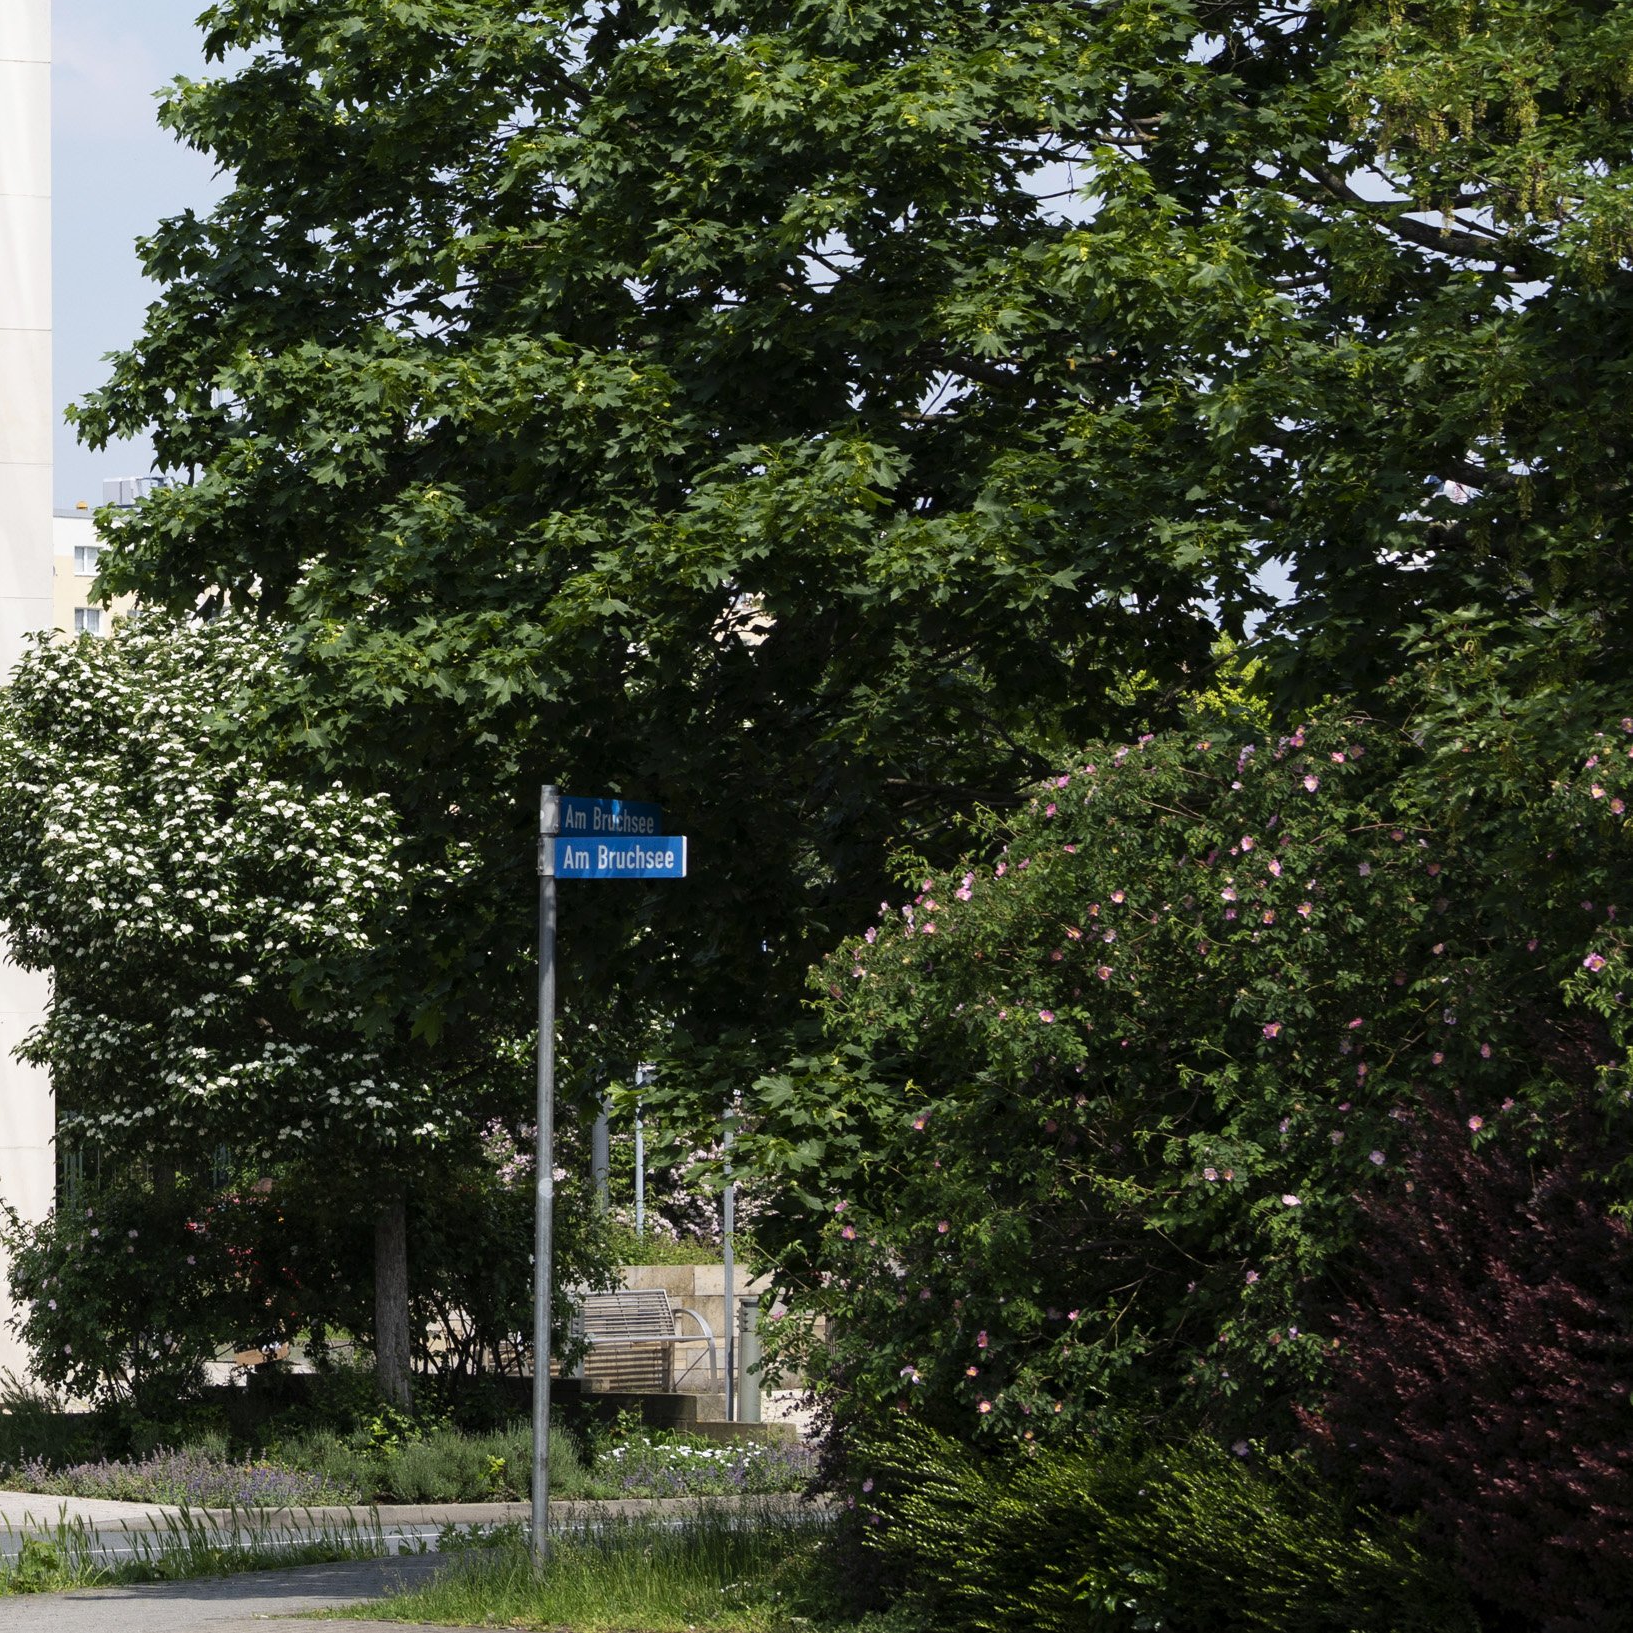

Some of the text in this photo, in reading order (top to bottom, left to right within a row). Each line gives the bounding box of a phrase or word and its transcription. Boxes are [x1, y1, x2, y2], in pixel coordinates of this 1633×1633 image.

[565, 804, 654, 834] Am Bruchsee
[563, 844, 674, 869] Am Bruchsee
